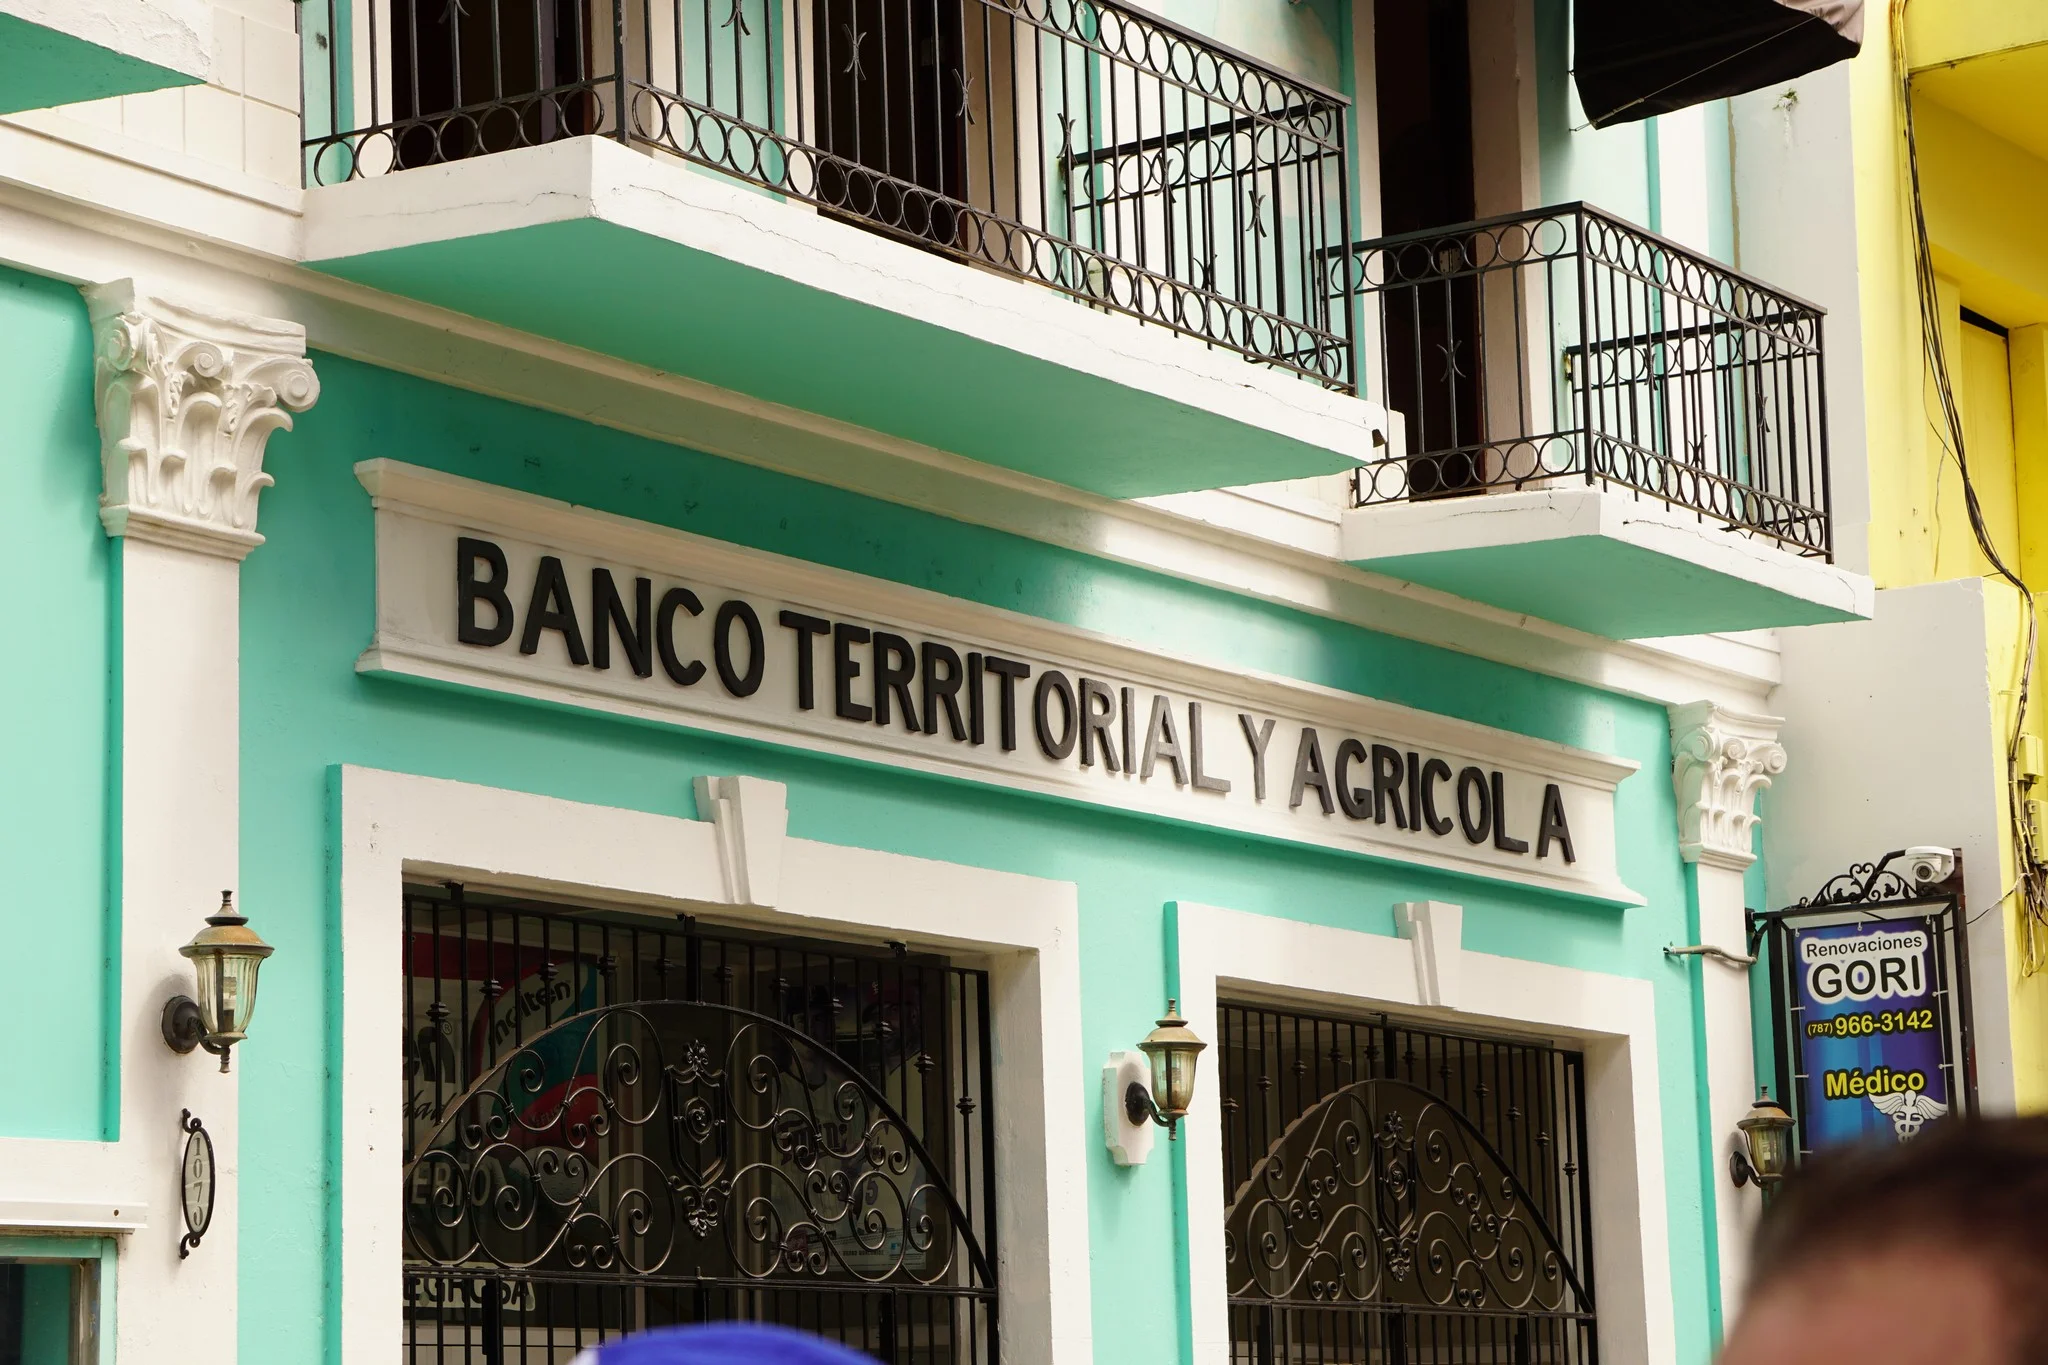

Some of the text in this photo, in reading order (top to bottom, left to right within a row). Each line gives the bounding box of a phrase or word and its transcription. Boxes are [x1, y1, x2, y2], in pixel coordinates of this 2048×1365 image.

[457, 536, 1577, 864] BANCO TERRITORIAL Y AGRICOLA
[1806, 936, 1922, 958] Renovaciones
[1812, 956, 1921, 998] GORI
[1807, 1009, 1934, 1037] (787) 966-3142
[1825, 1069, 1926, 1097] Médico
